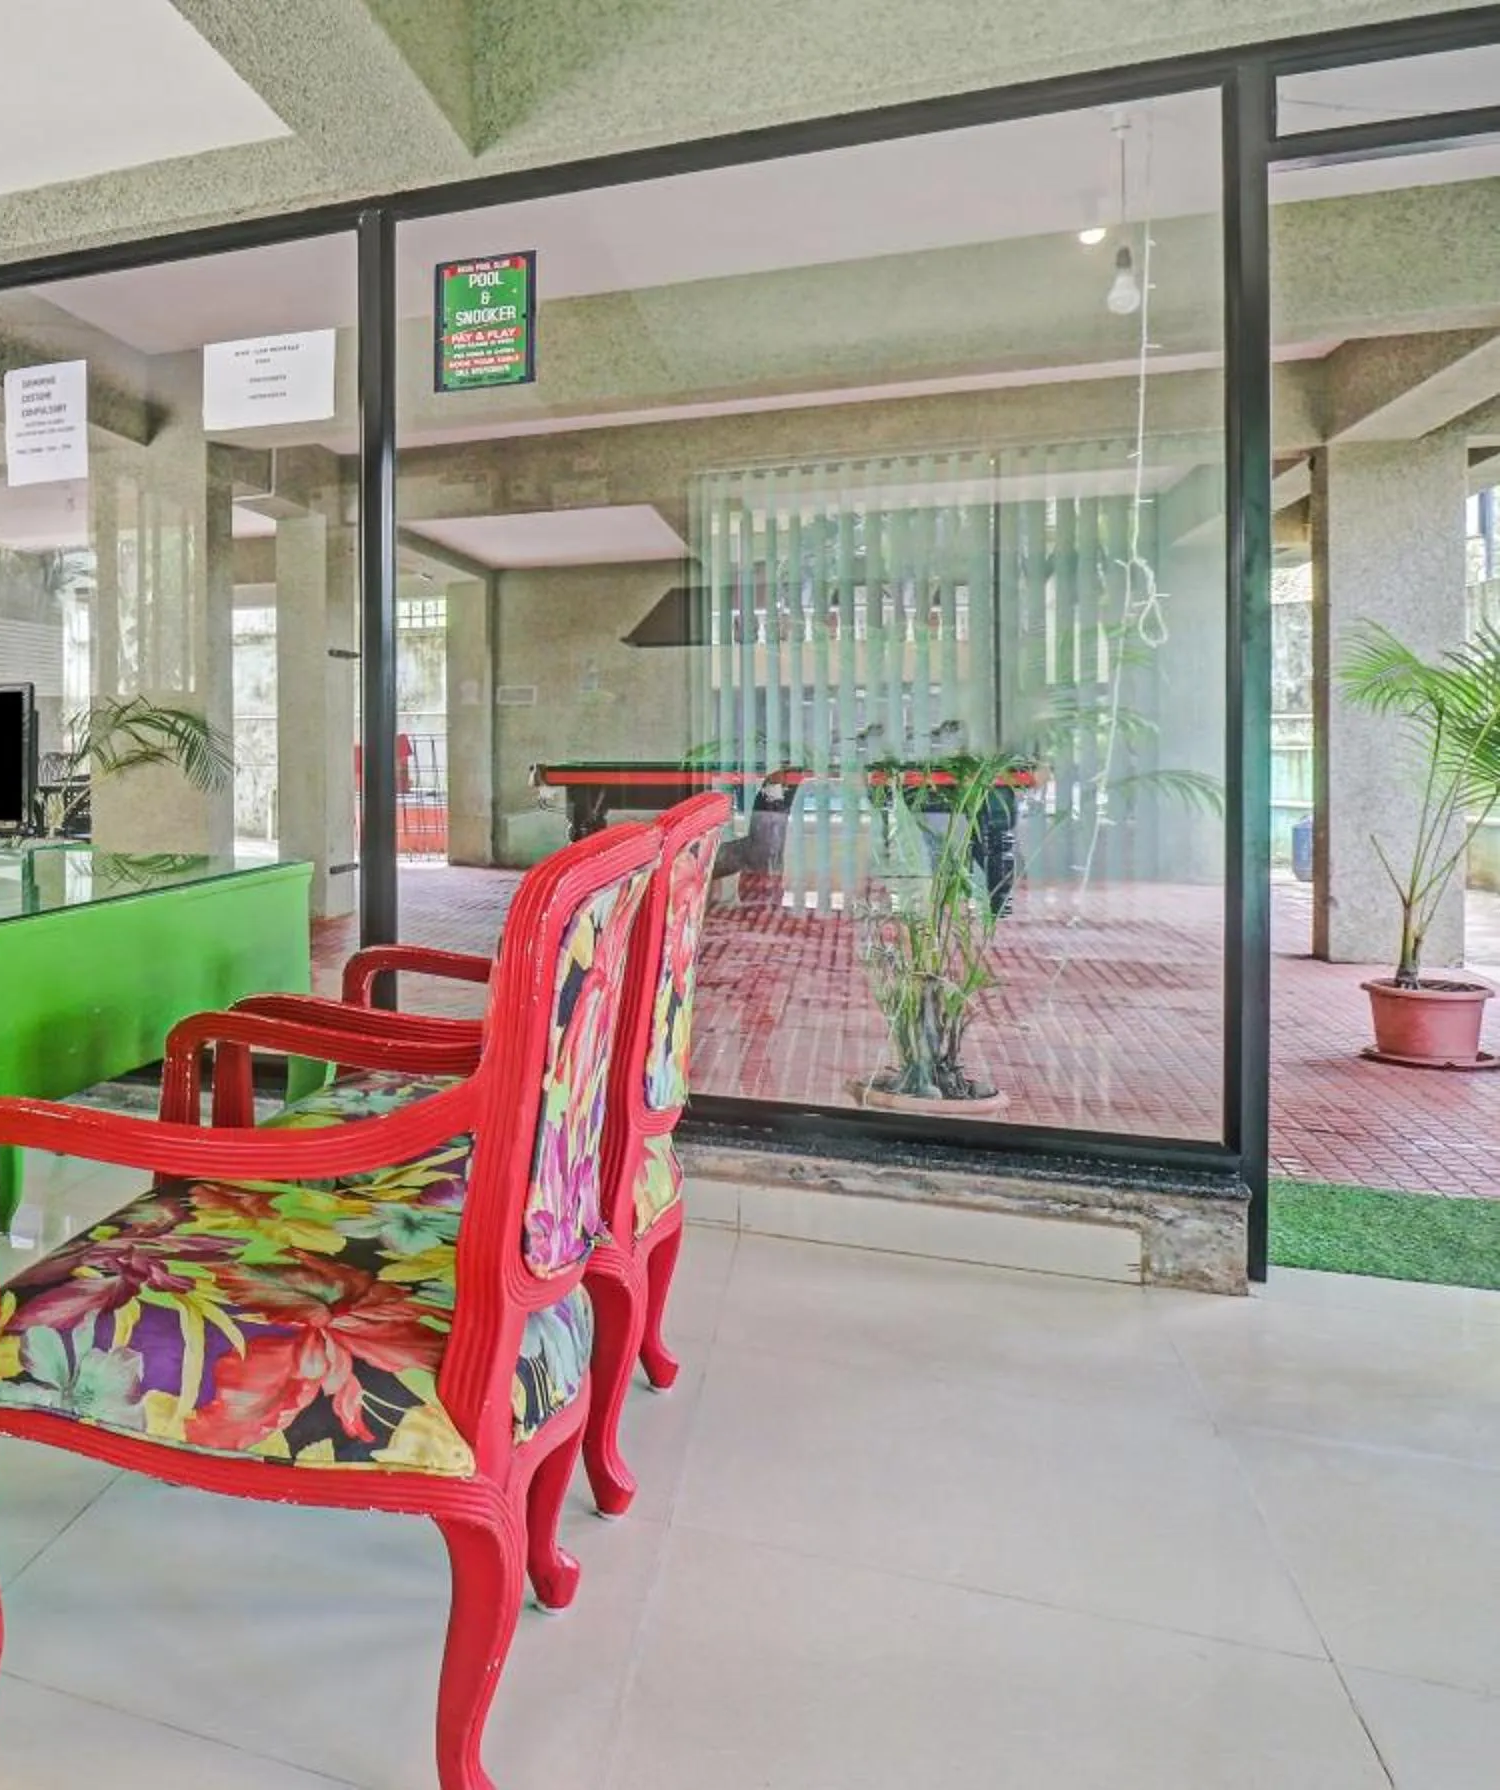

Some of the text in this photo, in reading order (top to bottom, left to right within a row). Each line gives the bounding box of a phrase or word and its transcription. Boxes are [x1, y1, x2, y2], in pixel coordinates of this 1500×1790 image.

[468, 271, 505, 288] POOL
[481, 291, 492, 305] &
[455, 305, 516, 327] SNOOKER
[488, 328, 517, 340] PLAY
